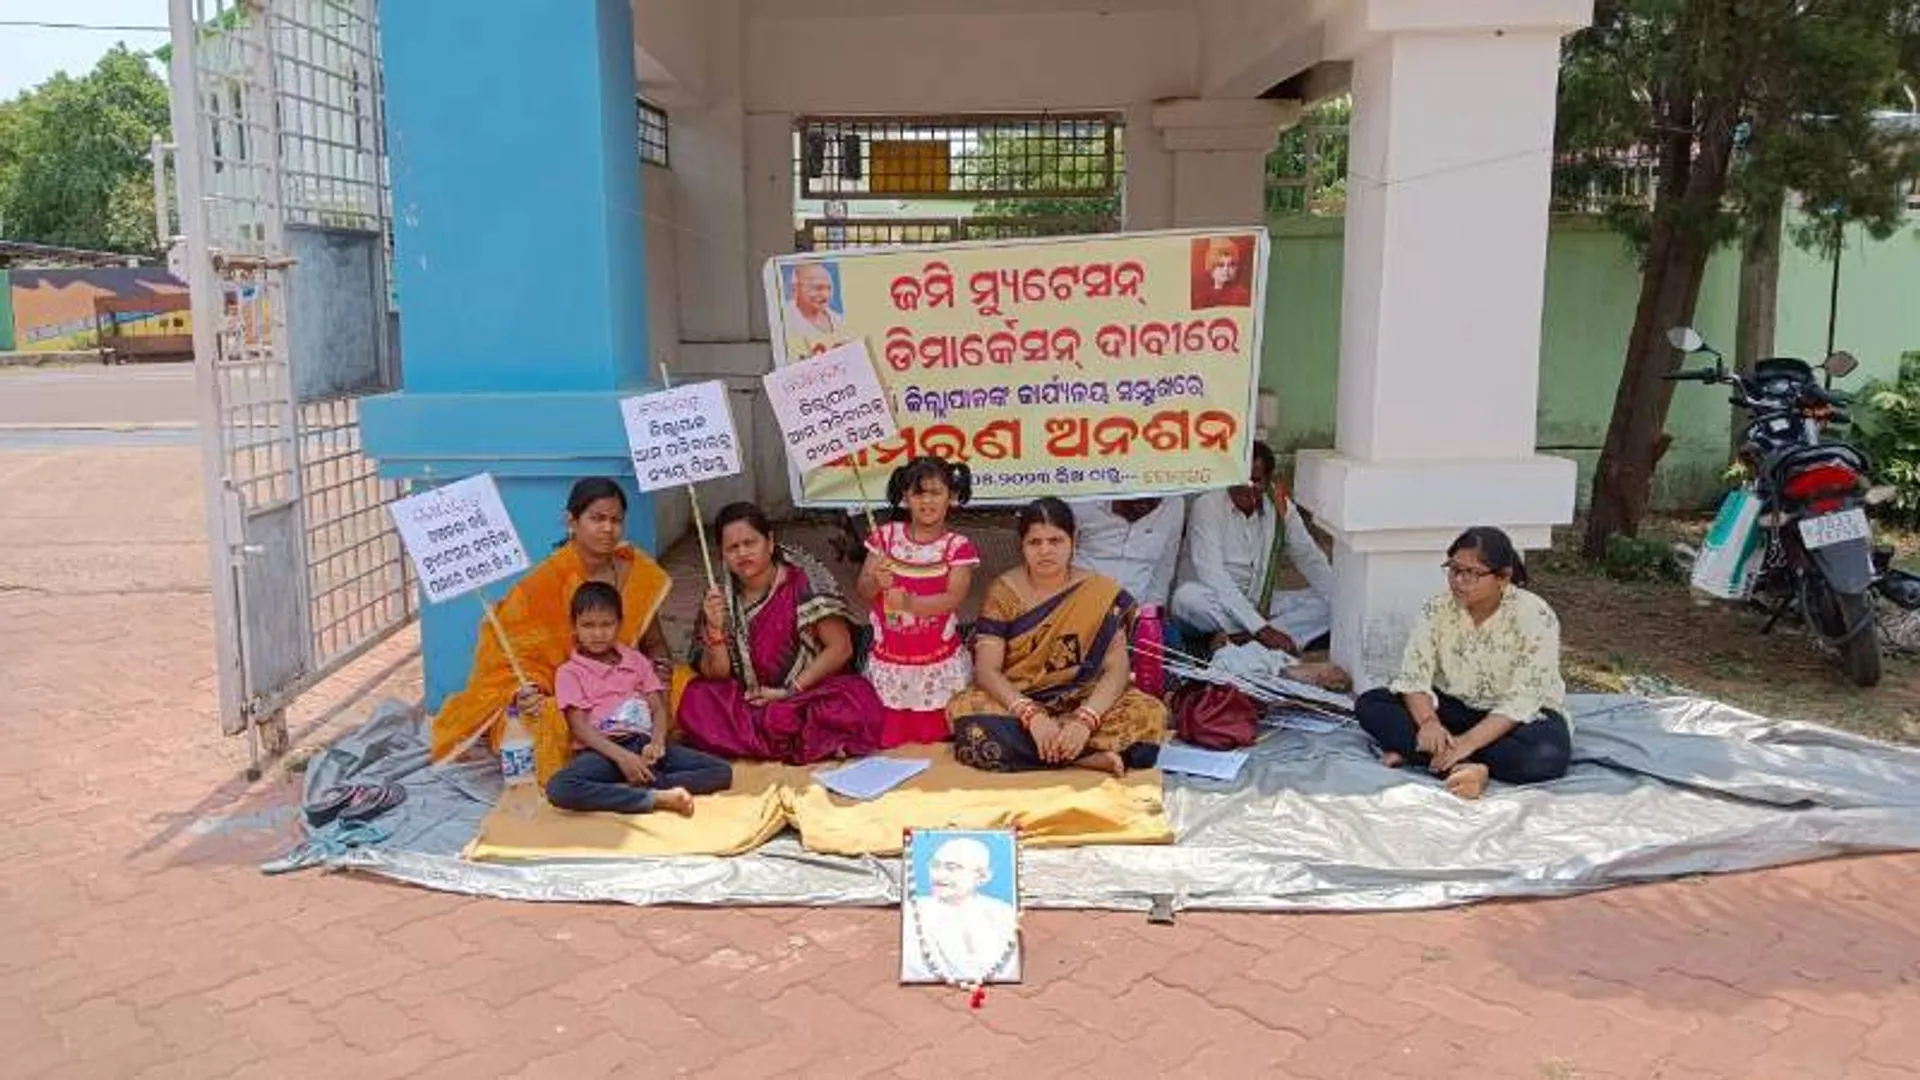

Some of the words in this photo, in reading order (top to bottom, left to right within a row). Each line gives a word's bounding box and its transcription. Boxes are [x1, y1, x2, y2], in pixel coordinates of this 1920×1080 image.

[890, 261, 955, 311] ଜମି
[969, 261, 1147, 316] ମ୍ୟୁଟେସନ୍
[1096, 317, 1240, 358] ଦାବୀରେ
[822, 418, 1021, 467] ମରଣ
[1045, 409, 1237, 459] ଅନଶନ
